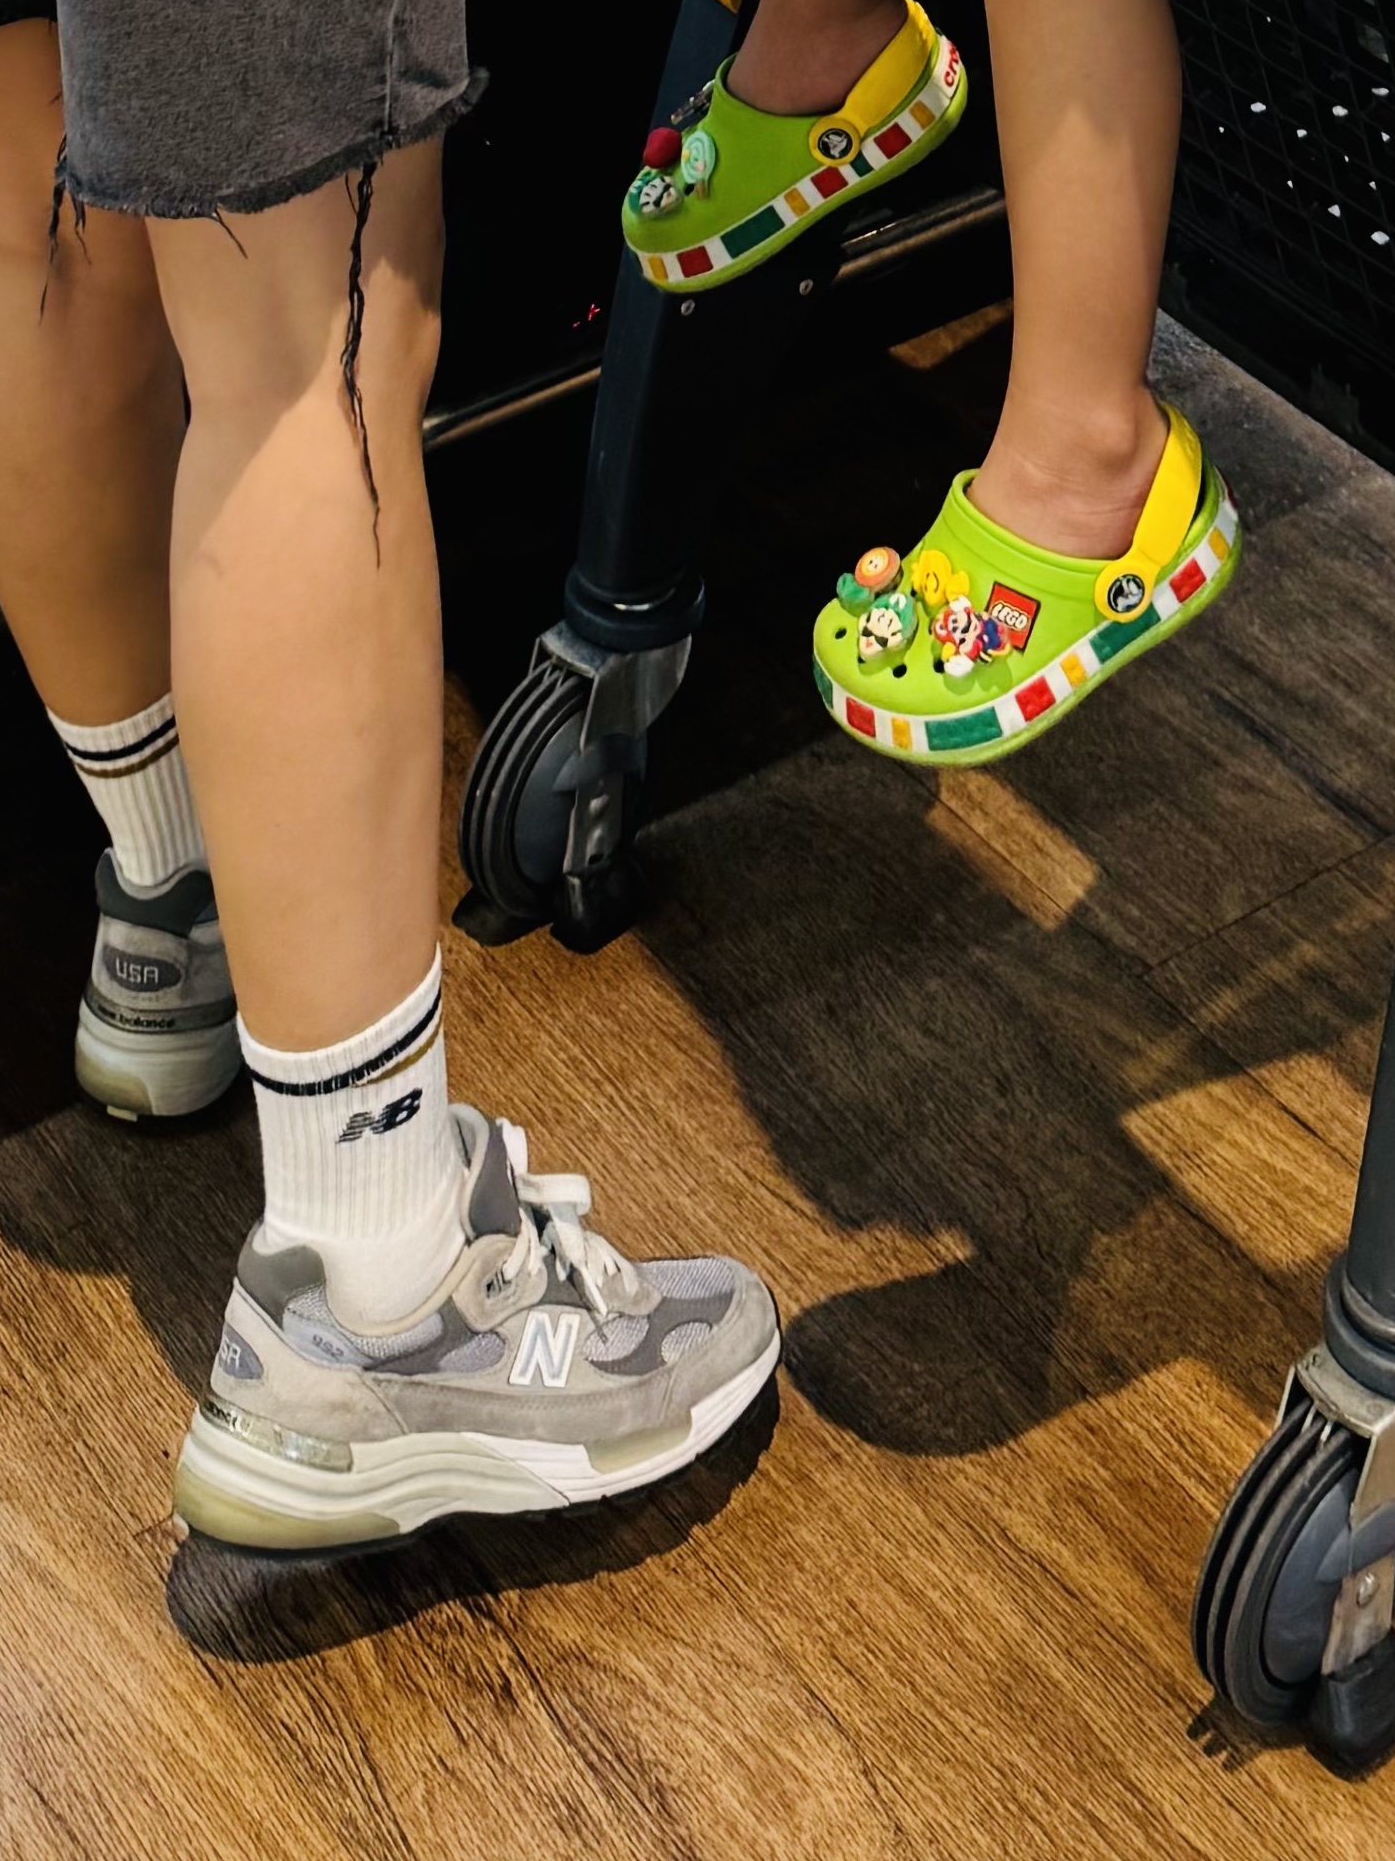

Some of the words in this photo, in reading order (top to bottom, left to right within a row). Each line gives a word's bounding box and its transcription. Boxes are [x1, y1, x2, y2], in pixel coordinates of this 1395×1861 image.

[991, 602, 1030, 629] LEGO
[115, 958, 159, 984] USA
[507, 1310, 583, 1389] N
